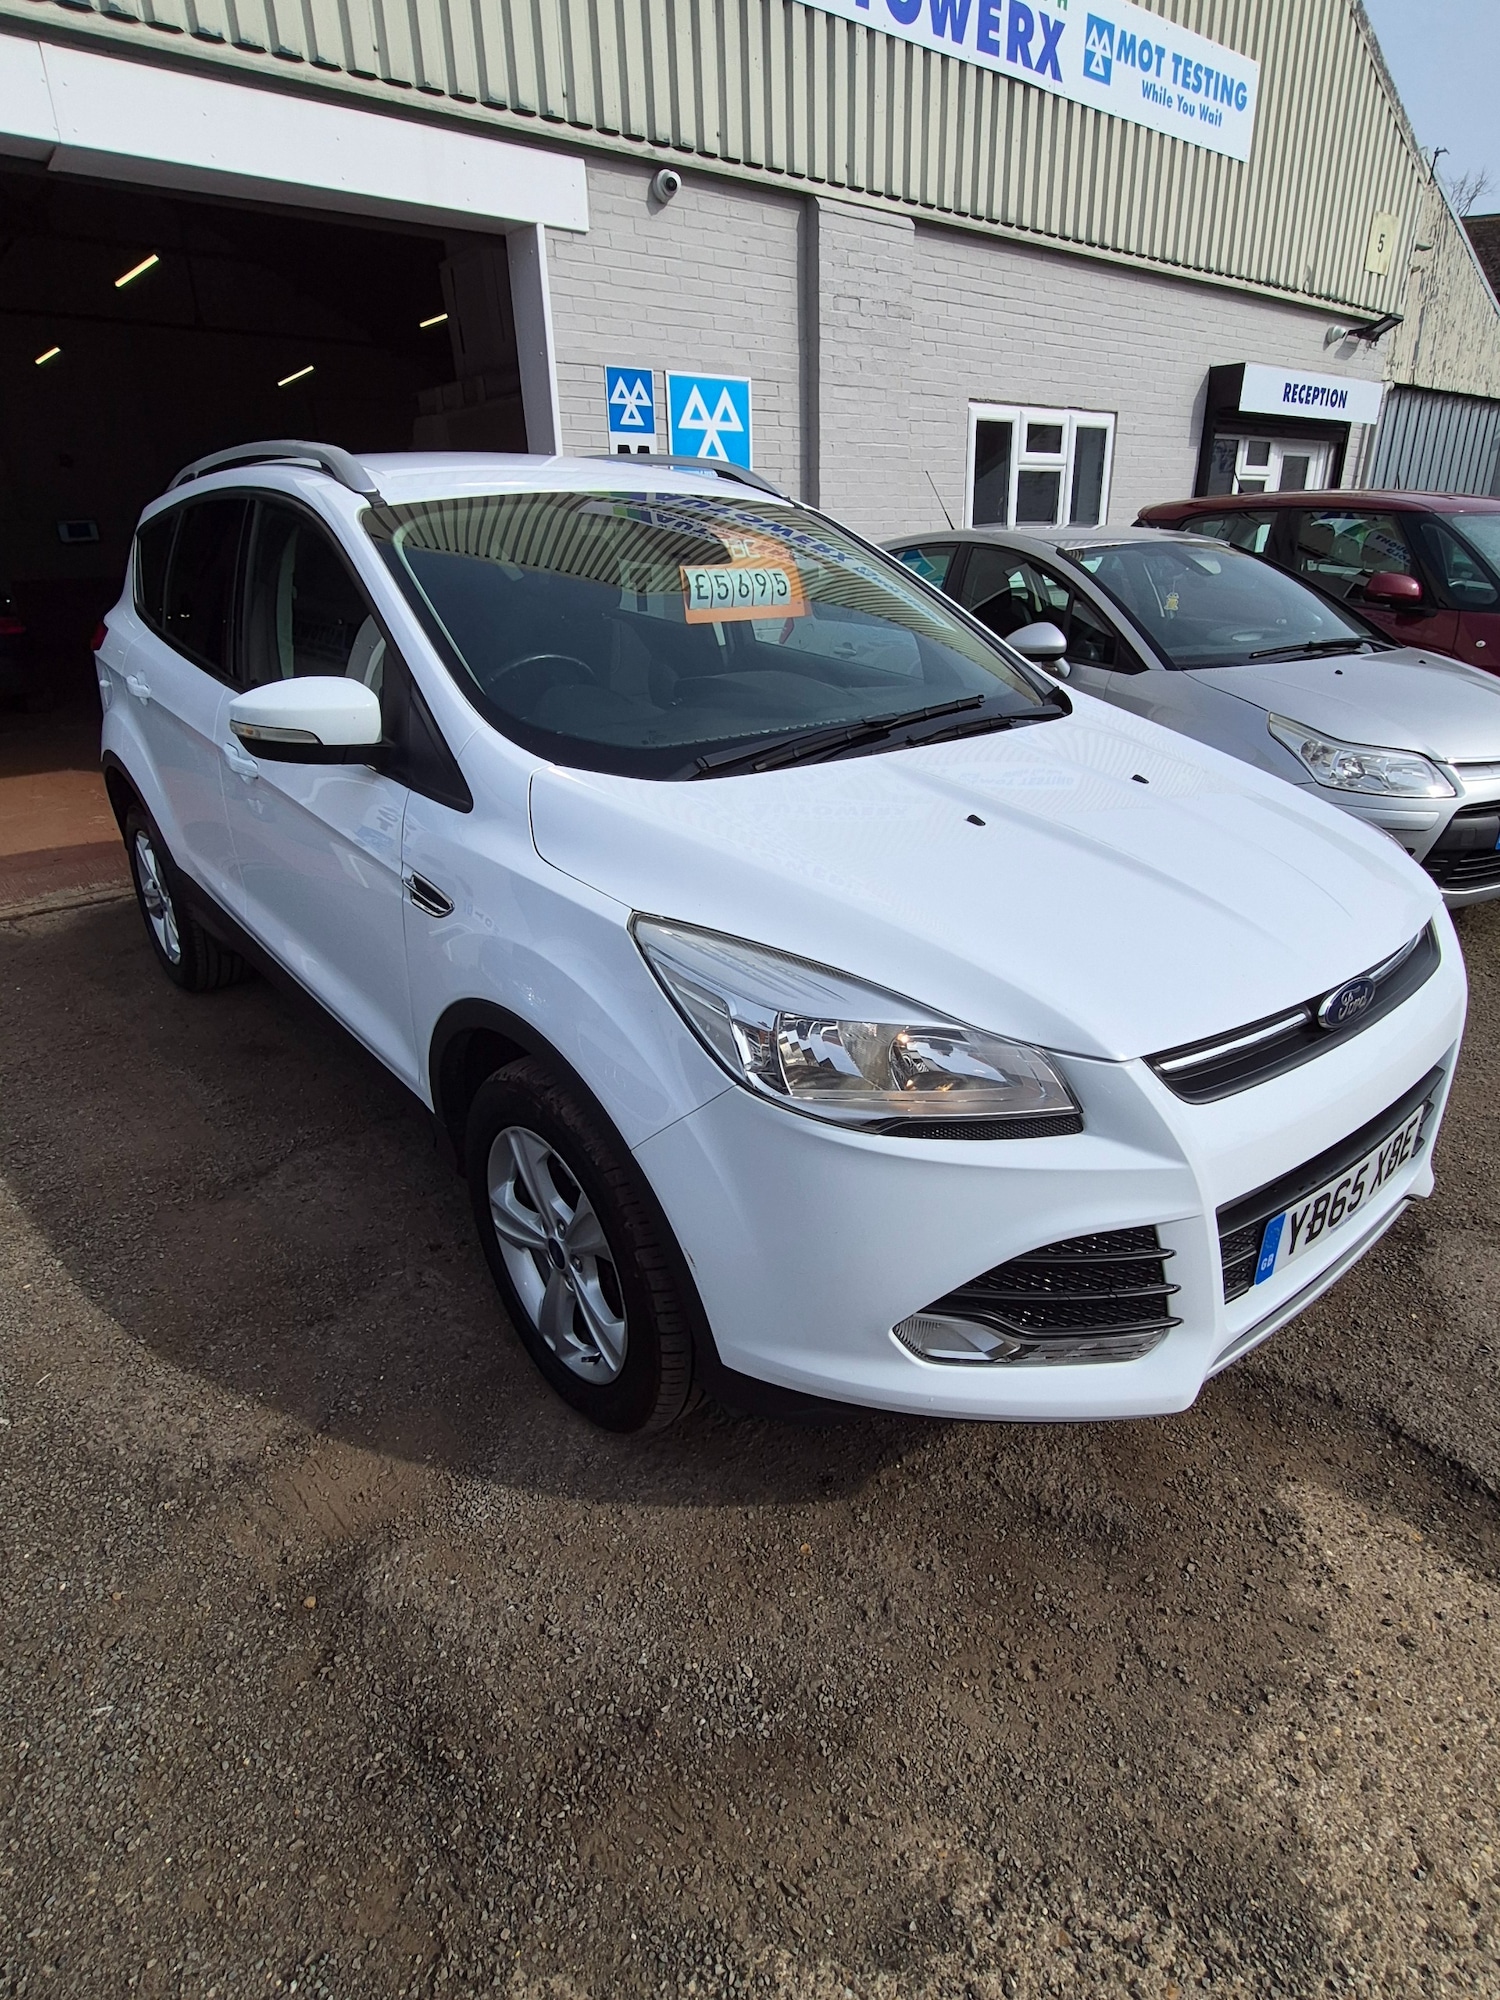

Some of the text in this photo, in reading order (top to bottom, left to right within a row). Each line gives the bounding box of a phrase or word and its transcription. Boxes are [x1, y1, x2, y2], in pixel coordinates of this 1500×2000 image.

[855, 0, 1066, 83] WERX
[1116, 29, 1248, 112] MOT TESTING
[1142, 80, 1223, 128] While You Wait
[1377, 233, 1386, 253] 5
[1282, 382, 1348, 409] RECEPTION
[695, 573, 788, 600] £5695
[1338, 985, 1368, 1020] Ford
[1288, 1116, 1419, 1255] YB65 XBE
[1260, 1253, 1274, 1271] GB
